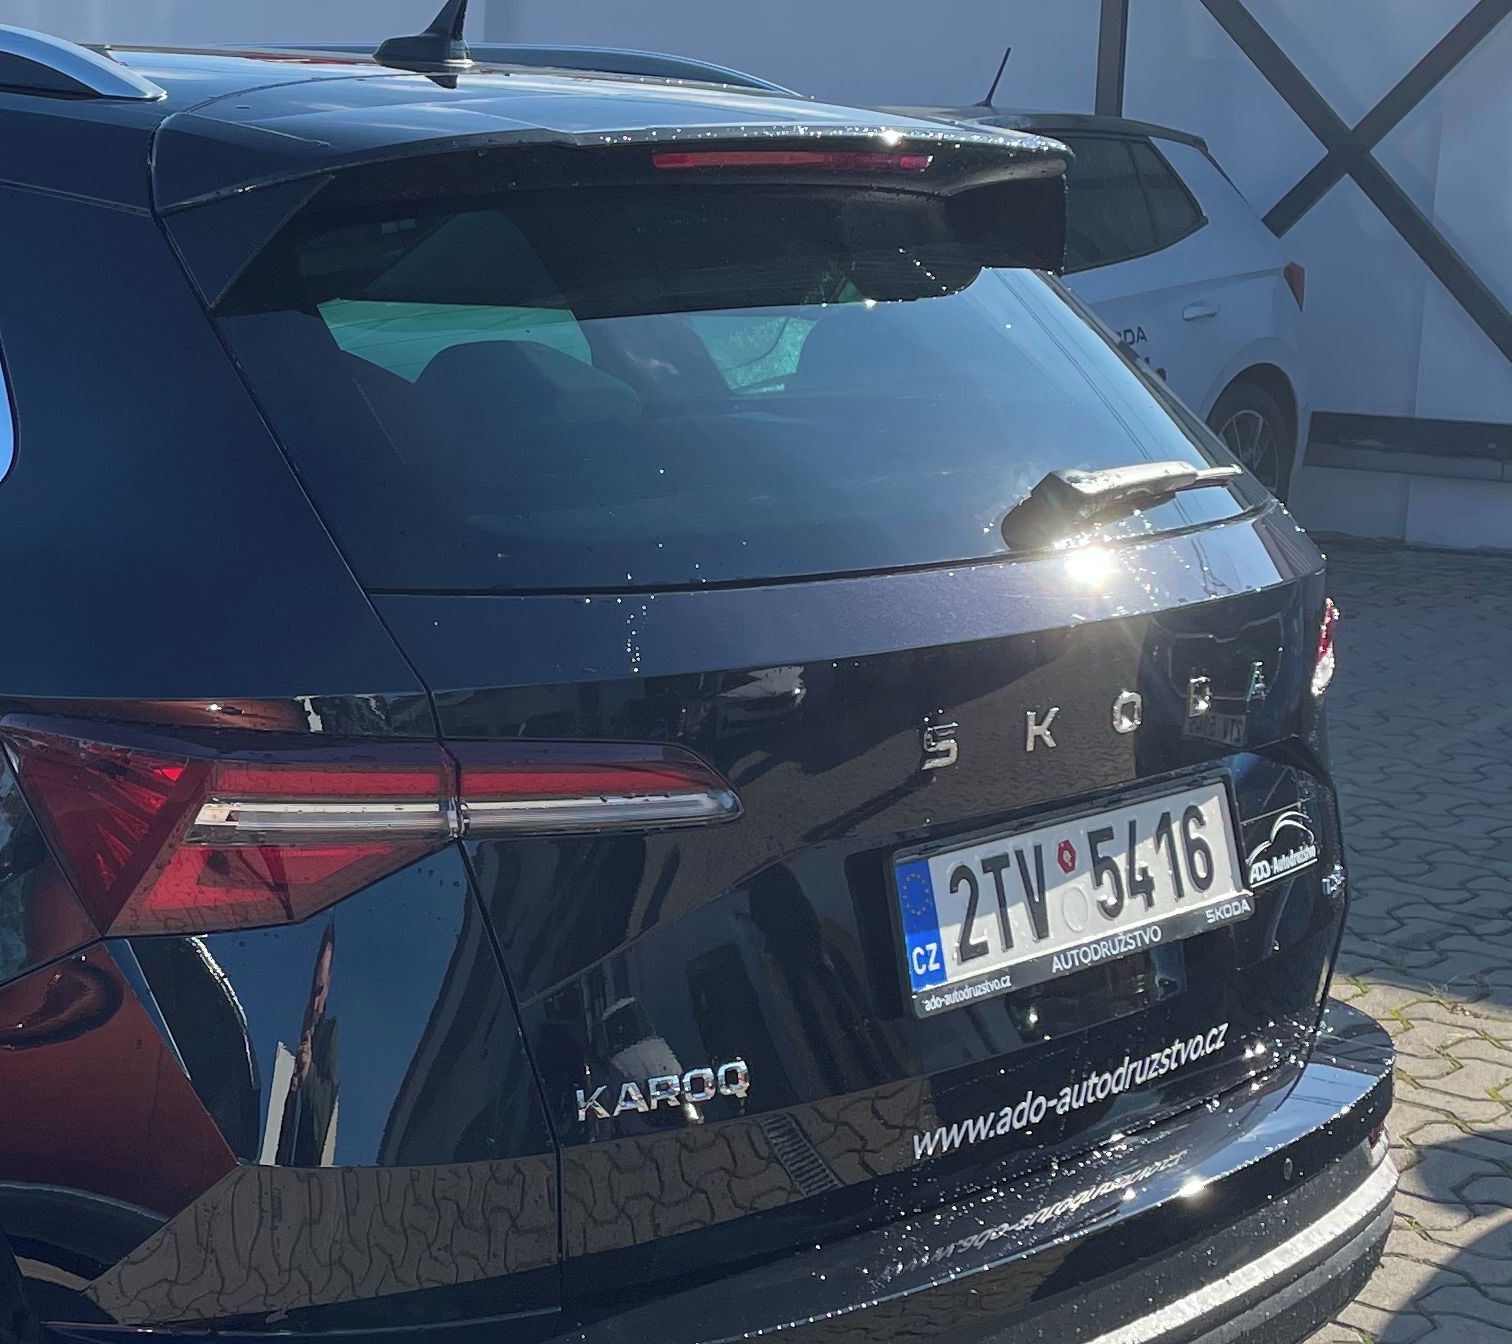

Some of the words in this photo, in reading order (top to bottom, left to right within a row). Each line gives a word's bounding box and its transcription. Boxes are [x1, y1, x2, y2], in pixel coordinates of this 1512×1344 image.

[911, 941, 941, 977] CZ
[949, 843, 1051, 966] 2TV
[1086, 804, 1216, 922] 5416
[1051, 925, 1163, 974] AUTODRUŽSTVO
[575, 1059, 752, 1122] KAROQ
[912, 1022, 1230, 1160] www.ado-autodruzstvo.cz
